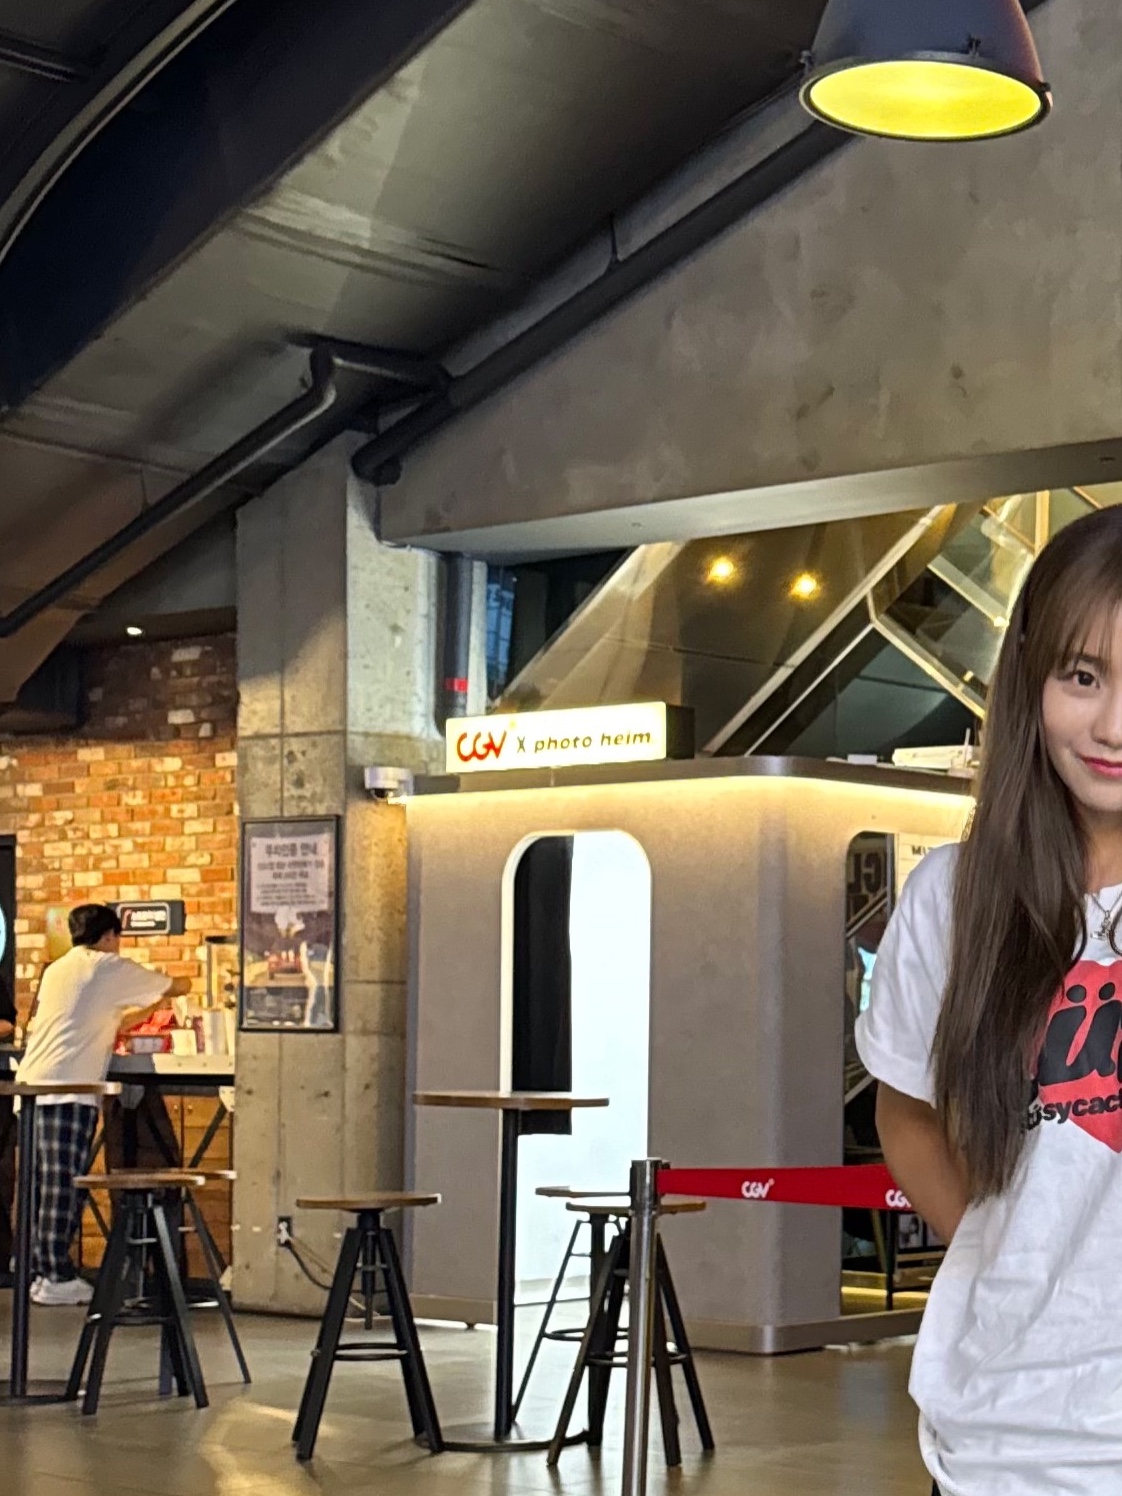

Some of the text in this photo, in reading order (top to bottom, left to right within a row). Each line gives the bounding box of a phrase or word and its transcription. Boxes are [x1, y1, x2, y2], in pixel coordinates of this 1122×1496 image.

[457, 731, 507, 761] CGV
[534, 736, 592, 754] photo
[601, 731, 651, 747] heim
[741, 1179, 775, 1199] CGV
[885, 1189, 911, 1207] CG
